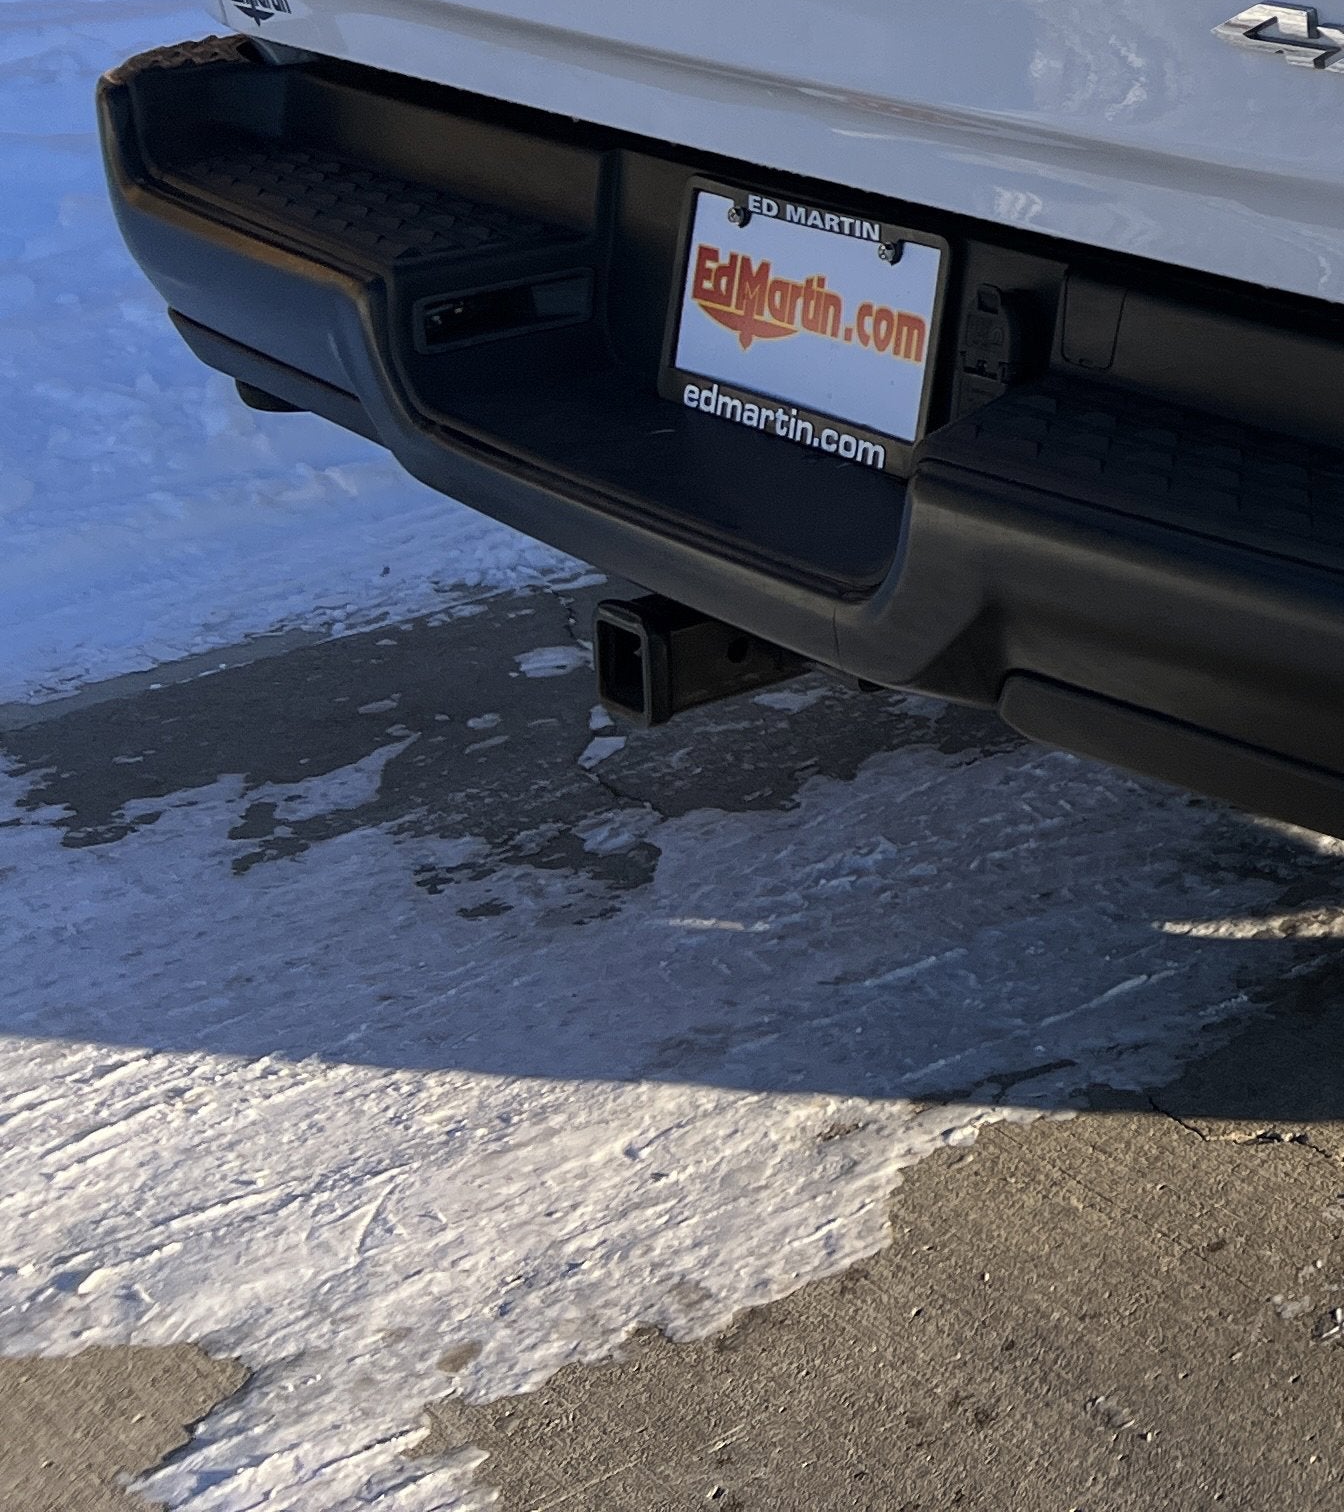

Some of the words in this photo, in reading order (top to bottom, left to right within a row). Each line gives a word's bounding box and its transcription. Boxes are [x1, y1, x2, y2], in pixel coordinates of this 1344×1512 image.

[748, 195, 779, 218] ED
[786, 206, 881, 241] MARTIN
[683, 382, 886, 471] edmartin.com
